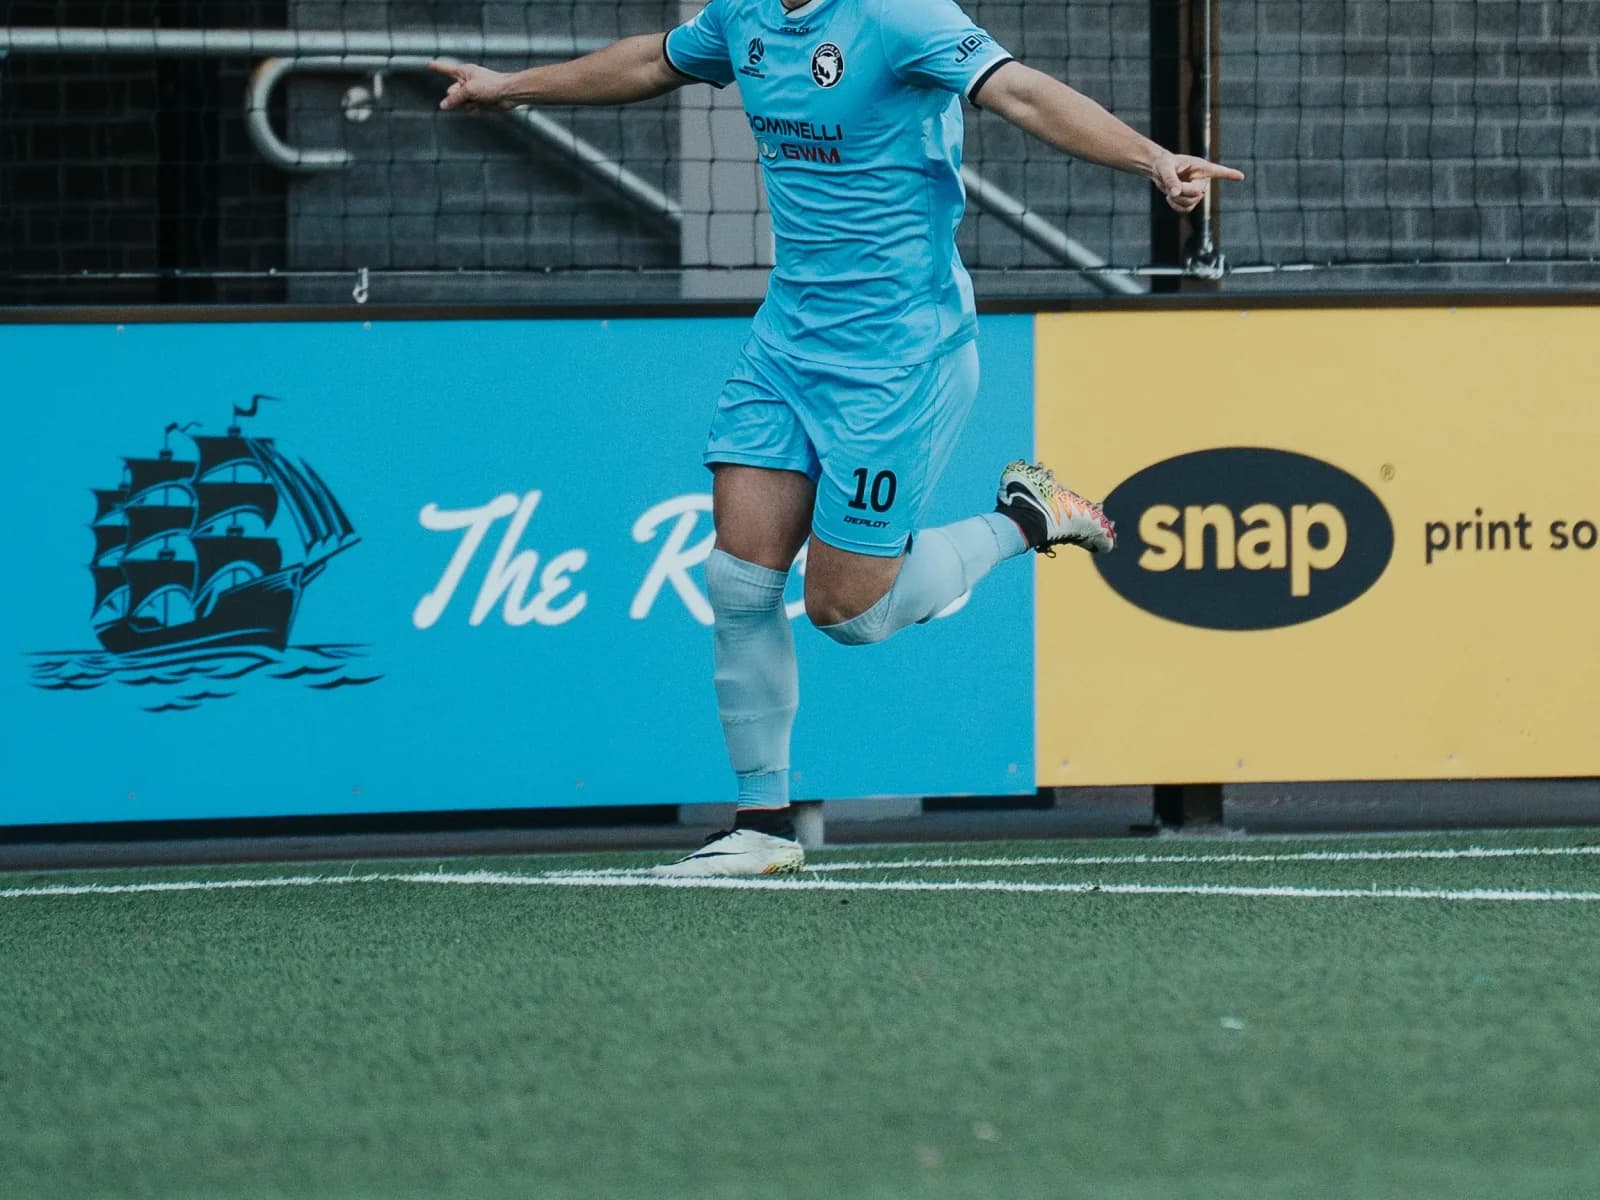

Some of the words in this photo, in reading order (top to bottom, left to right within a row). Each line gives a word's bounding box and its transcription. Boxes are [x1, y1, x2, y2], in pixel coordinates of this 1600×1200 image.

[781, 143, 841, 163] GWM
[848, 467, 897, 513] 10
[412, 489, 588, 629] The
[1137, 502, 1348, 597] snap
[1425, 506, 1533, 565] print
[1549, 519, 1599, 551] so
